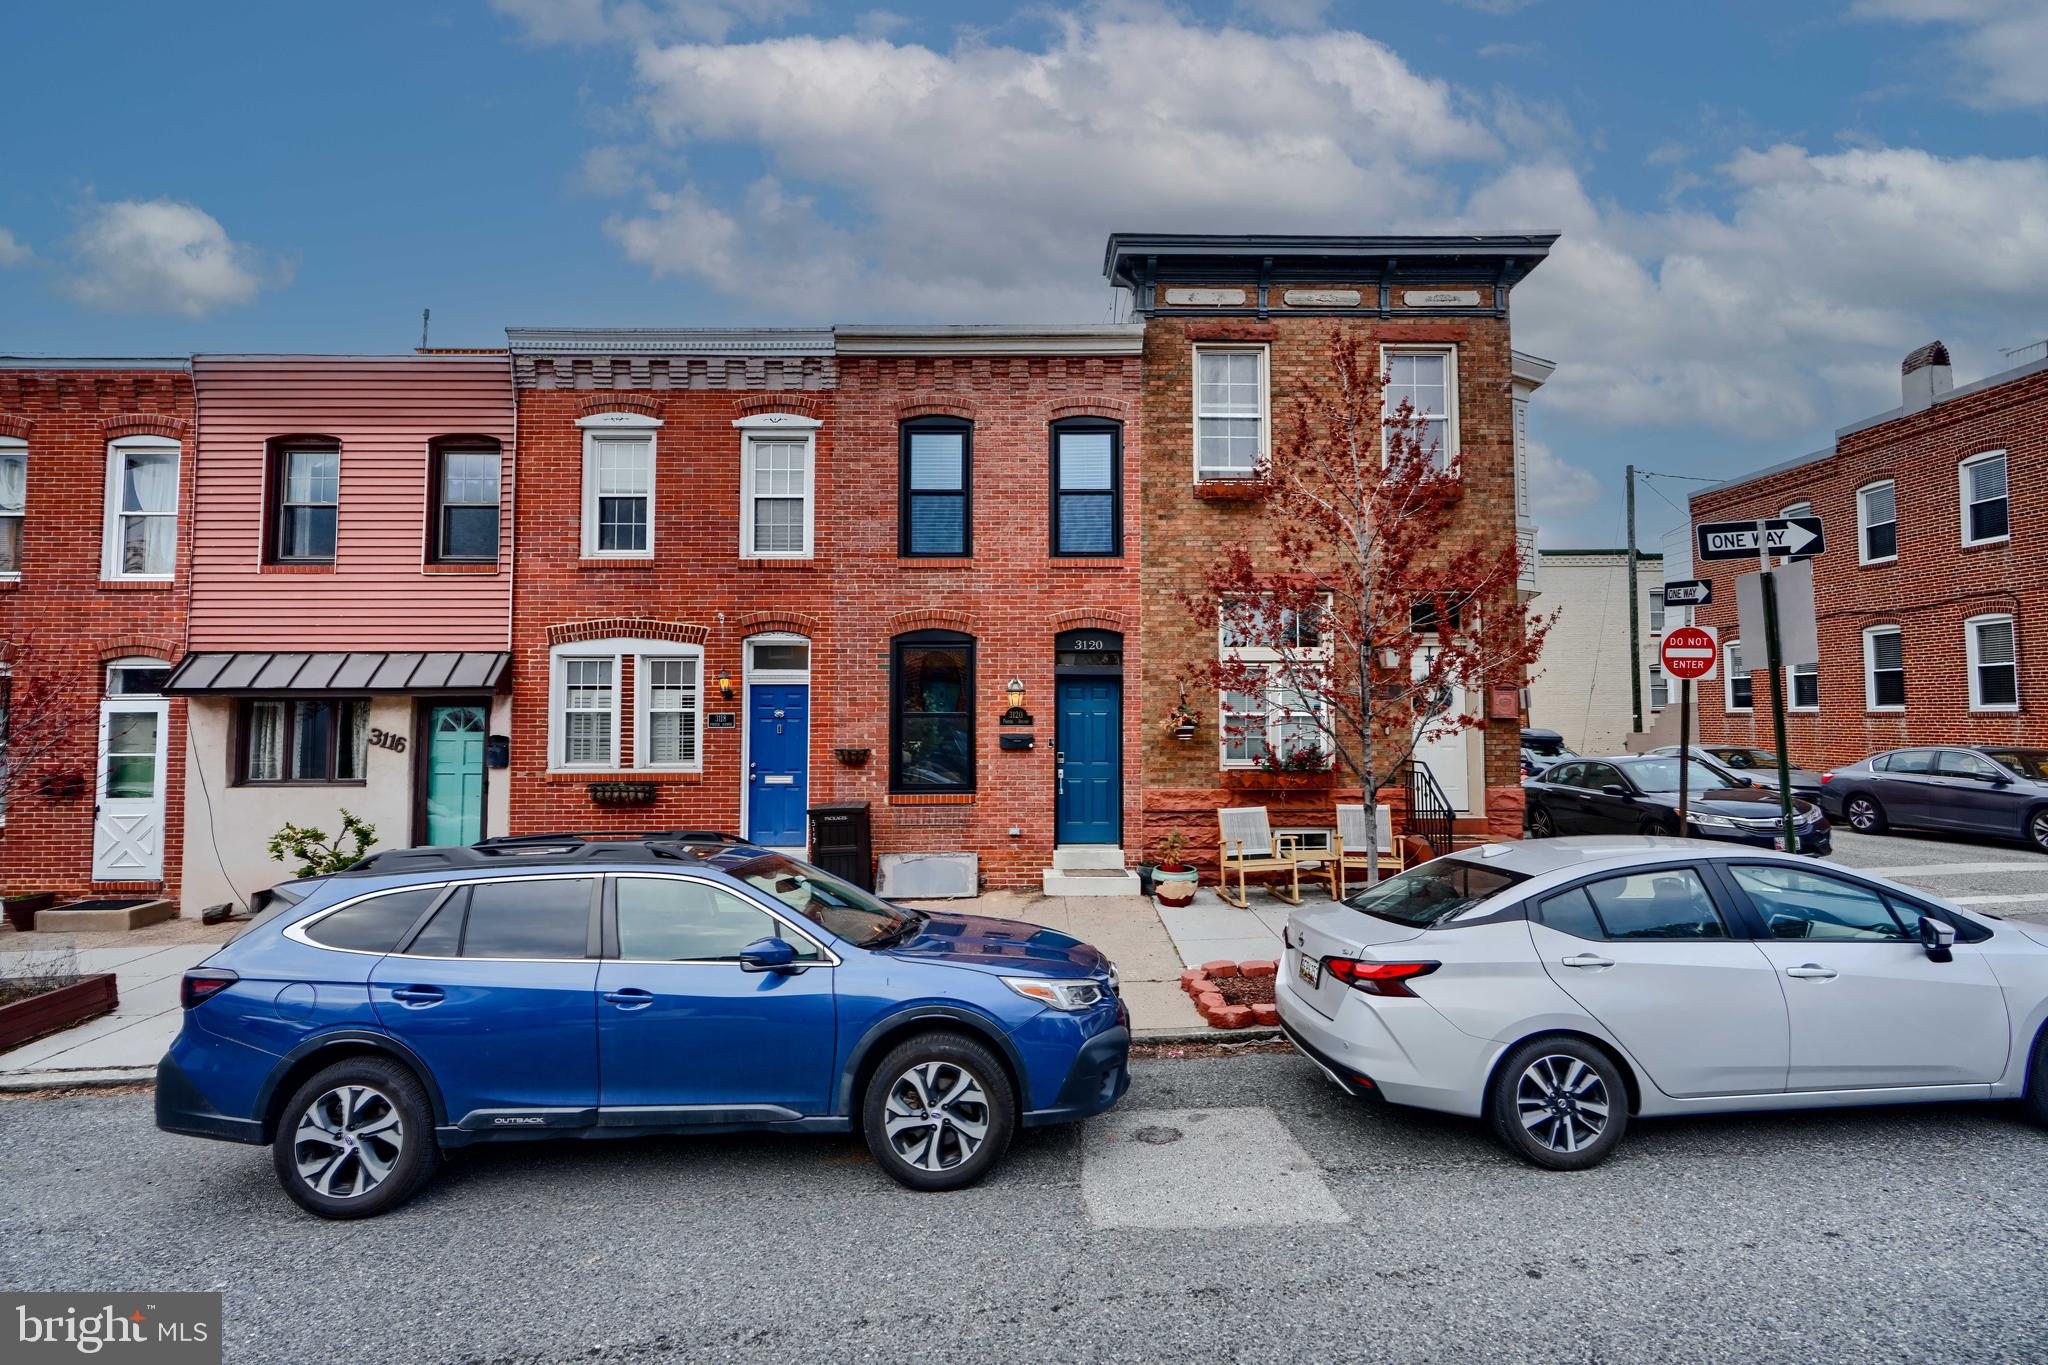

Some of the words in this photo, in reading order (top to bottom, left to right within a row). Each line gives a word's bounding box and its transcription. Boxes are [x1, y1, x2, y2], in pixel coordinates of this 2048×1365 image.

[1712, 533, 1747, 549] ONE
[1751, 530, 1785, 547] WAY
[1668, 588, 1682, 599] ONE
[1682, 587, 1697, 598] WAY
[1074, 639, 1103, 650] 3120
[1669, 637, 1684, 646] DO
[1687, 637, 1708, 646] NOT
[1673, 660, 1704, 669] ENTER
[1009, 710, 1023, 719] 3120
[368, 728, 407, 753] 3116
